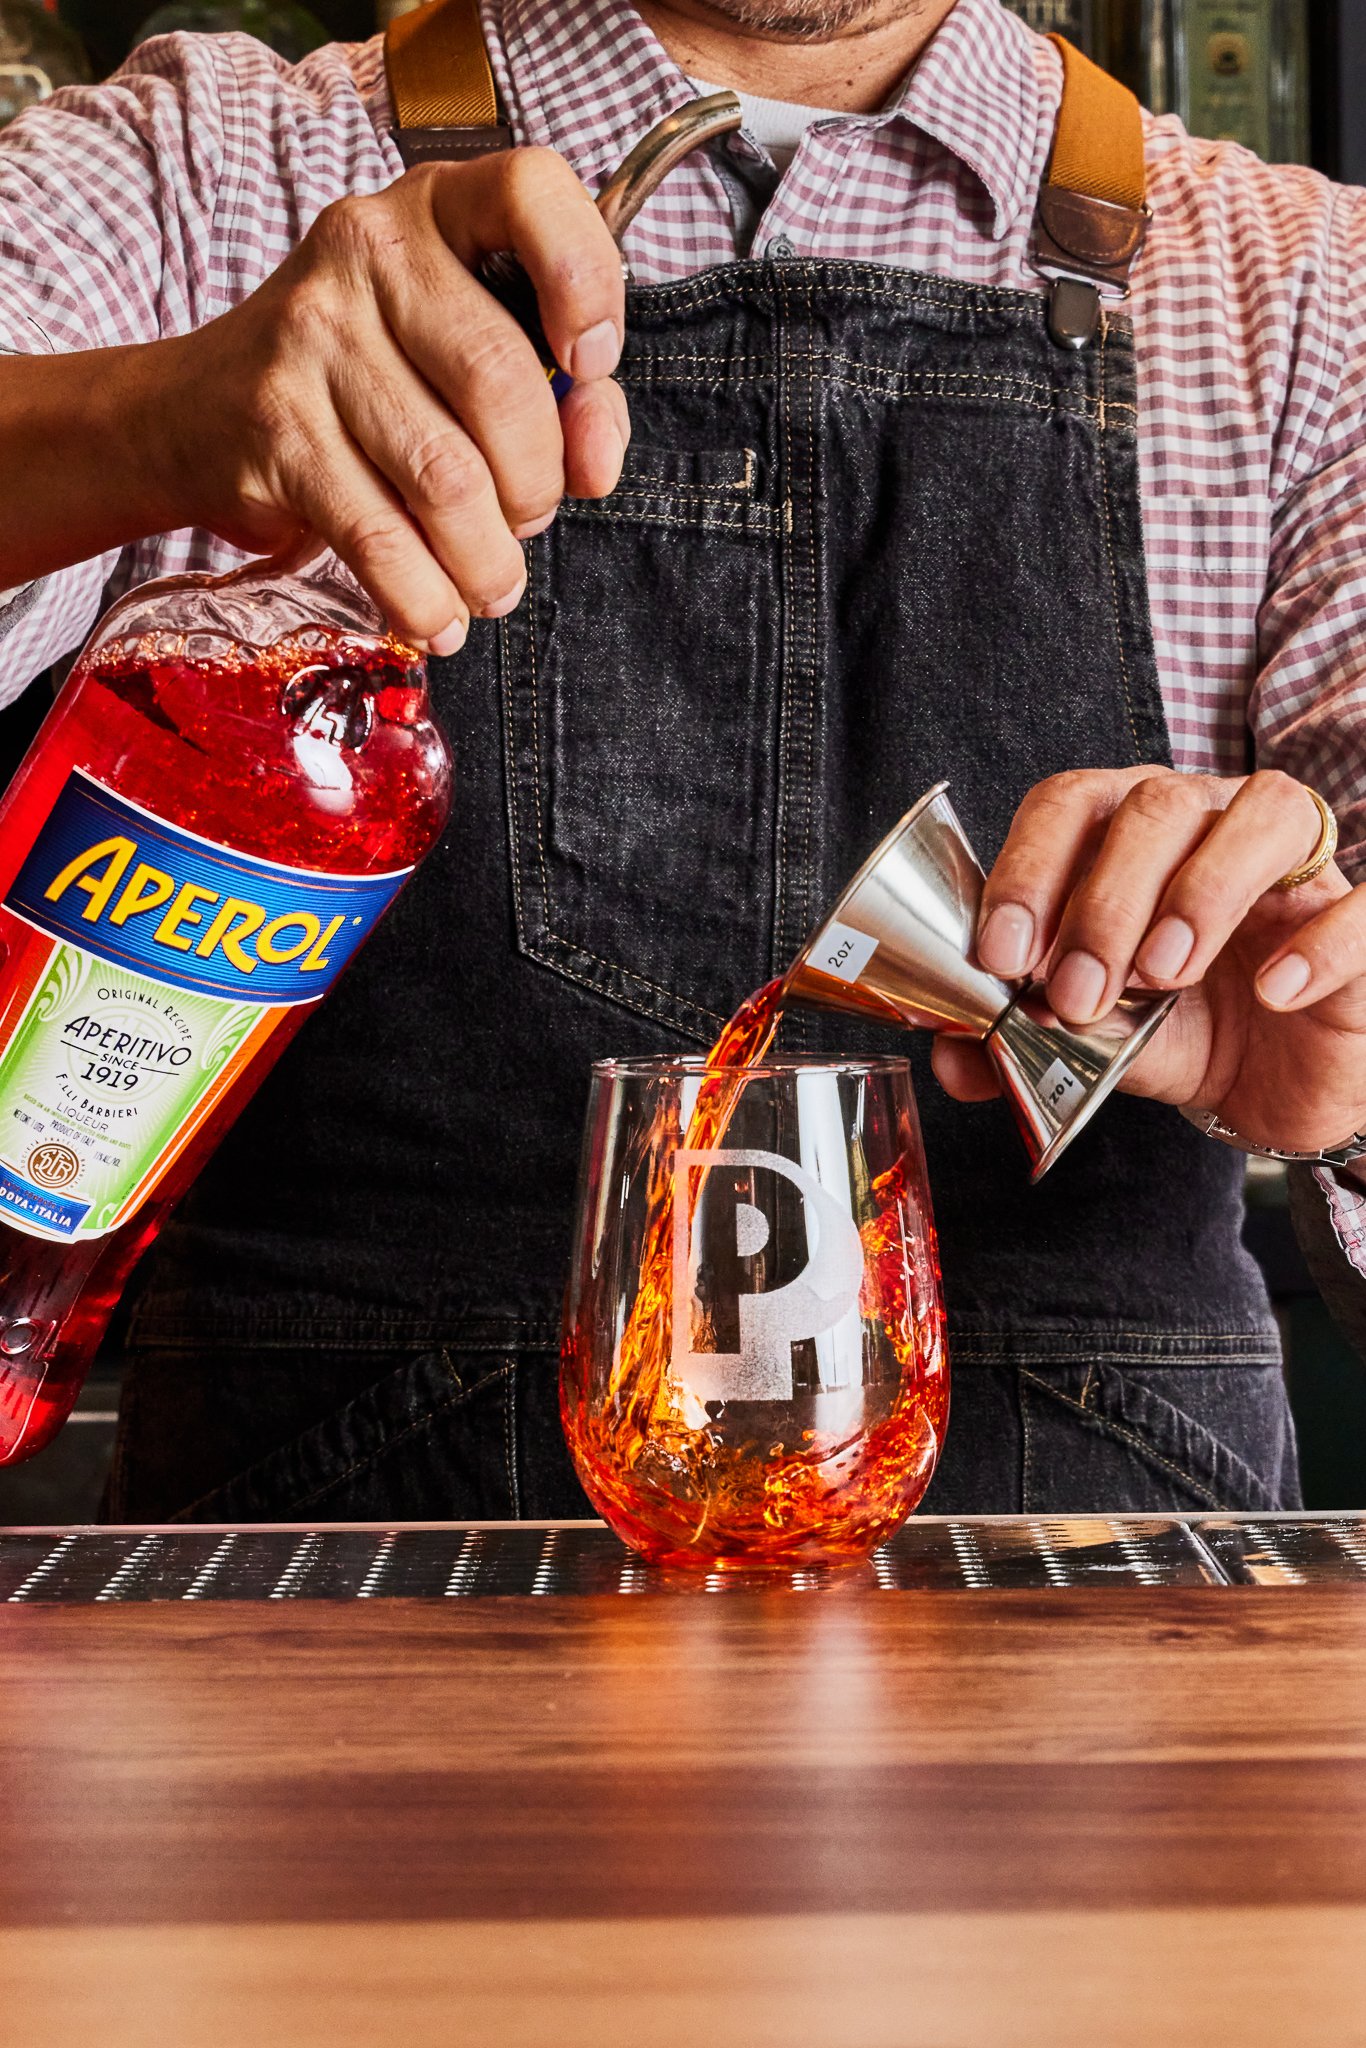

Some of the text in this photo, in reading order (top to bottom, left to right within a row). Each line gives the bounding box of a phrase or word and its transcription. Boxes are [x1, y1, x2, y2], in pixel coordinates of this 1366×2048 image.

[44, 834, 347, 974] APEROL
[828, 941, 855, 968] 2oz
[98, 988, 193, 1041] ORIGINAL RECIPE
[64, 1016, 192, 1066] APERITIVO
[80, 1062, 139, 1091] 1919
[100, 1053, 139, 1071] SINCE
[1049, 1077, 1074, 1104] 1oz
[56, 1102, 109, 1132] LIQUEUR
[80, 1099, 138, 1118] BARBIERI
